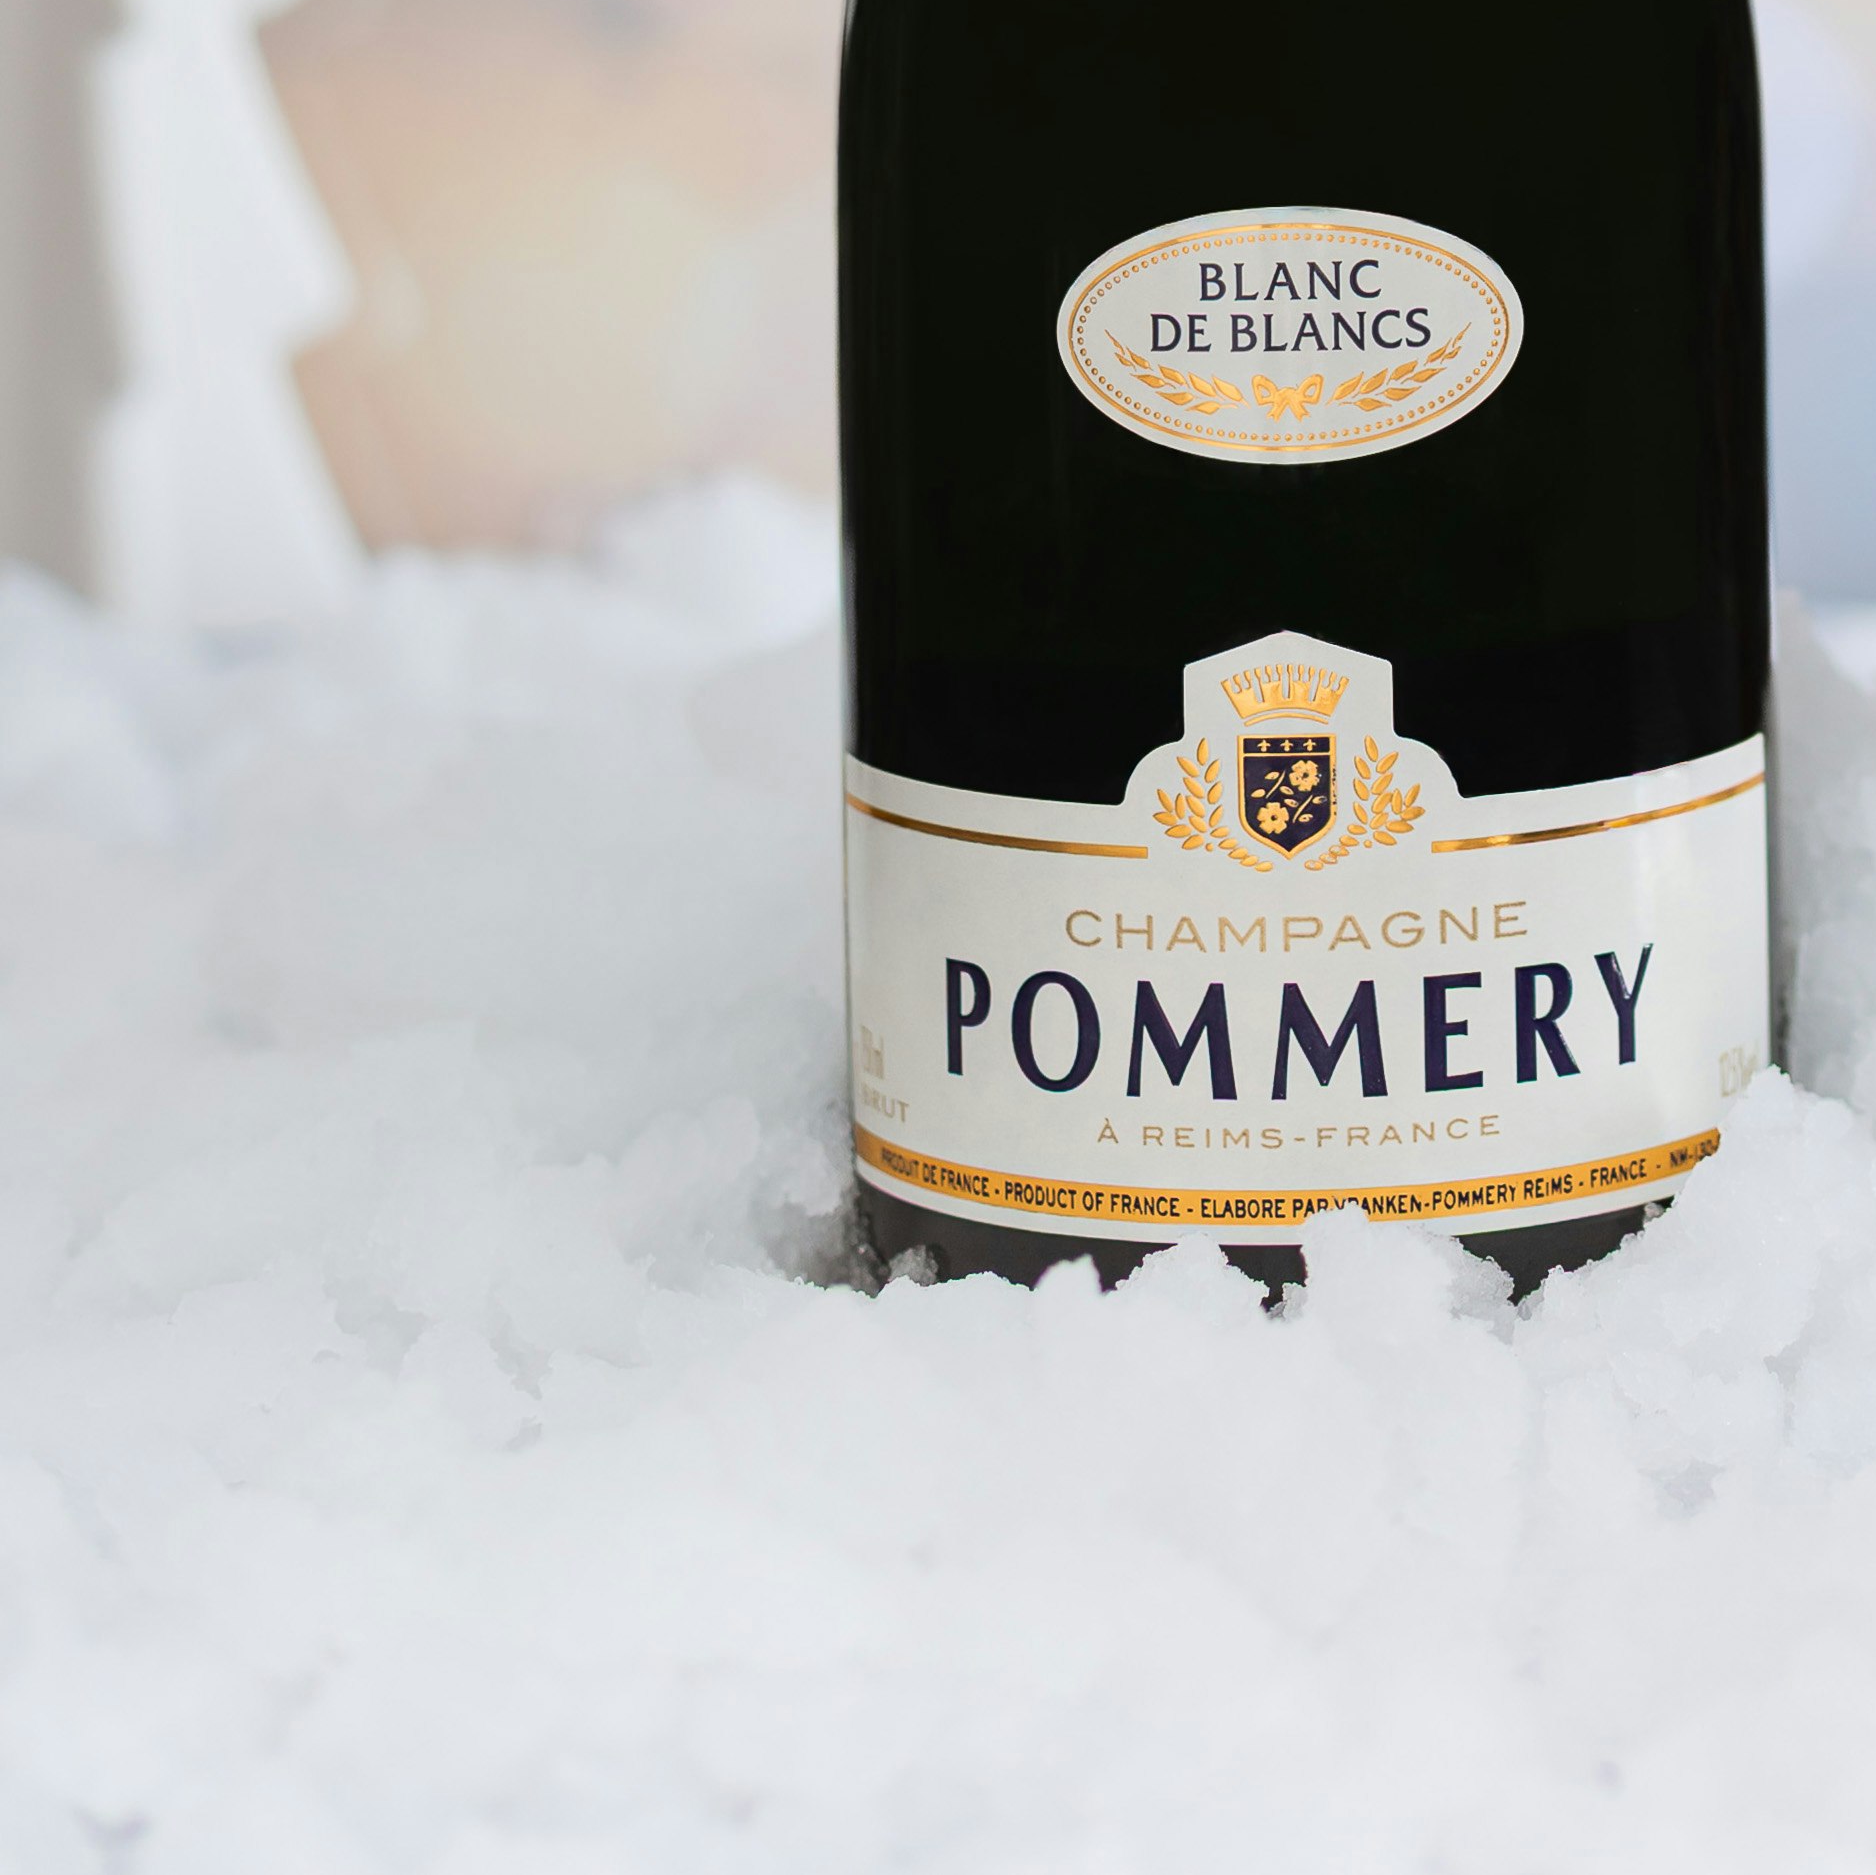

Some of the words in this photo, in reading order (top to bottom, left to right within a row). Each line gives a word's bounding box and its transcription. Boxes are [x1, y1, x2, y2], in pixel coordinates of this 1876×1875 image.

[1199, 259, 1383, 302] BLANC
[1150, 312, 1212, 354] DE
[1229, 307, 1432, 354] BLANCS
[1064, 900, 1530, 954] CHAMPAGNE
[944, 943, 1654, 1101] POMMERY
[1097, 1117, 1119, 1144] À
[1142, 1114, 1501, 1149] REIMS-FRANCE
[923, 1161, 937, 1185] DE
[940, 1167, 990, 1197] FRANCE
[1005, 1181, 1077, 1210] PRODUCT
[1083, 1190, 1104, 1212] OF
[1110, 1194, 1180, 1217] FRANCE
[1201, 1198, 1286, 1219] ELABORE
[1293, 1198, 1329, 1219] PAR
[1590, 1158, 1647, 1188] FRANCE
